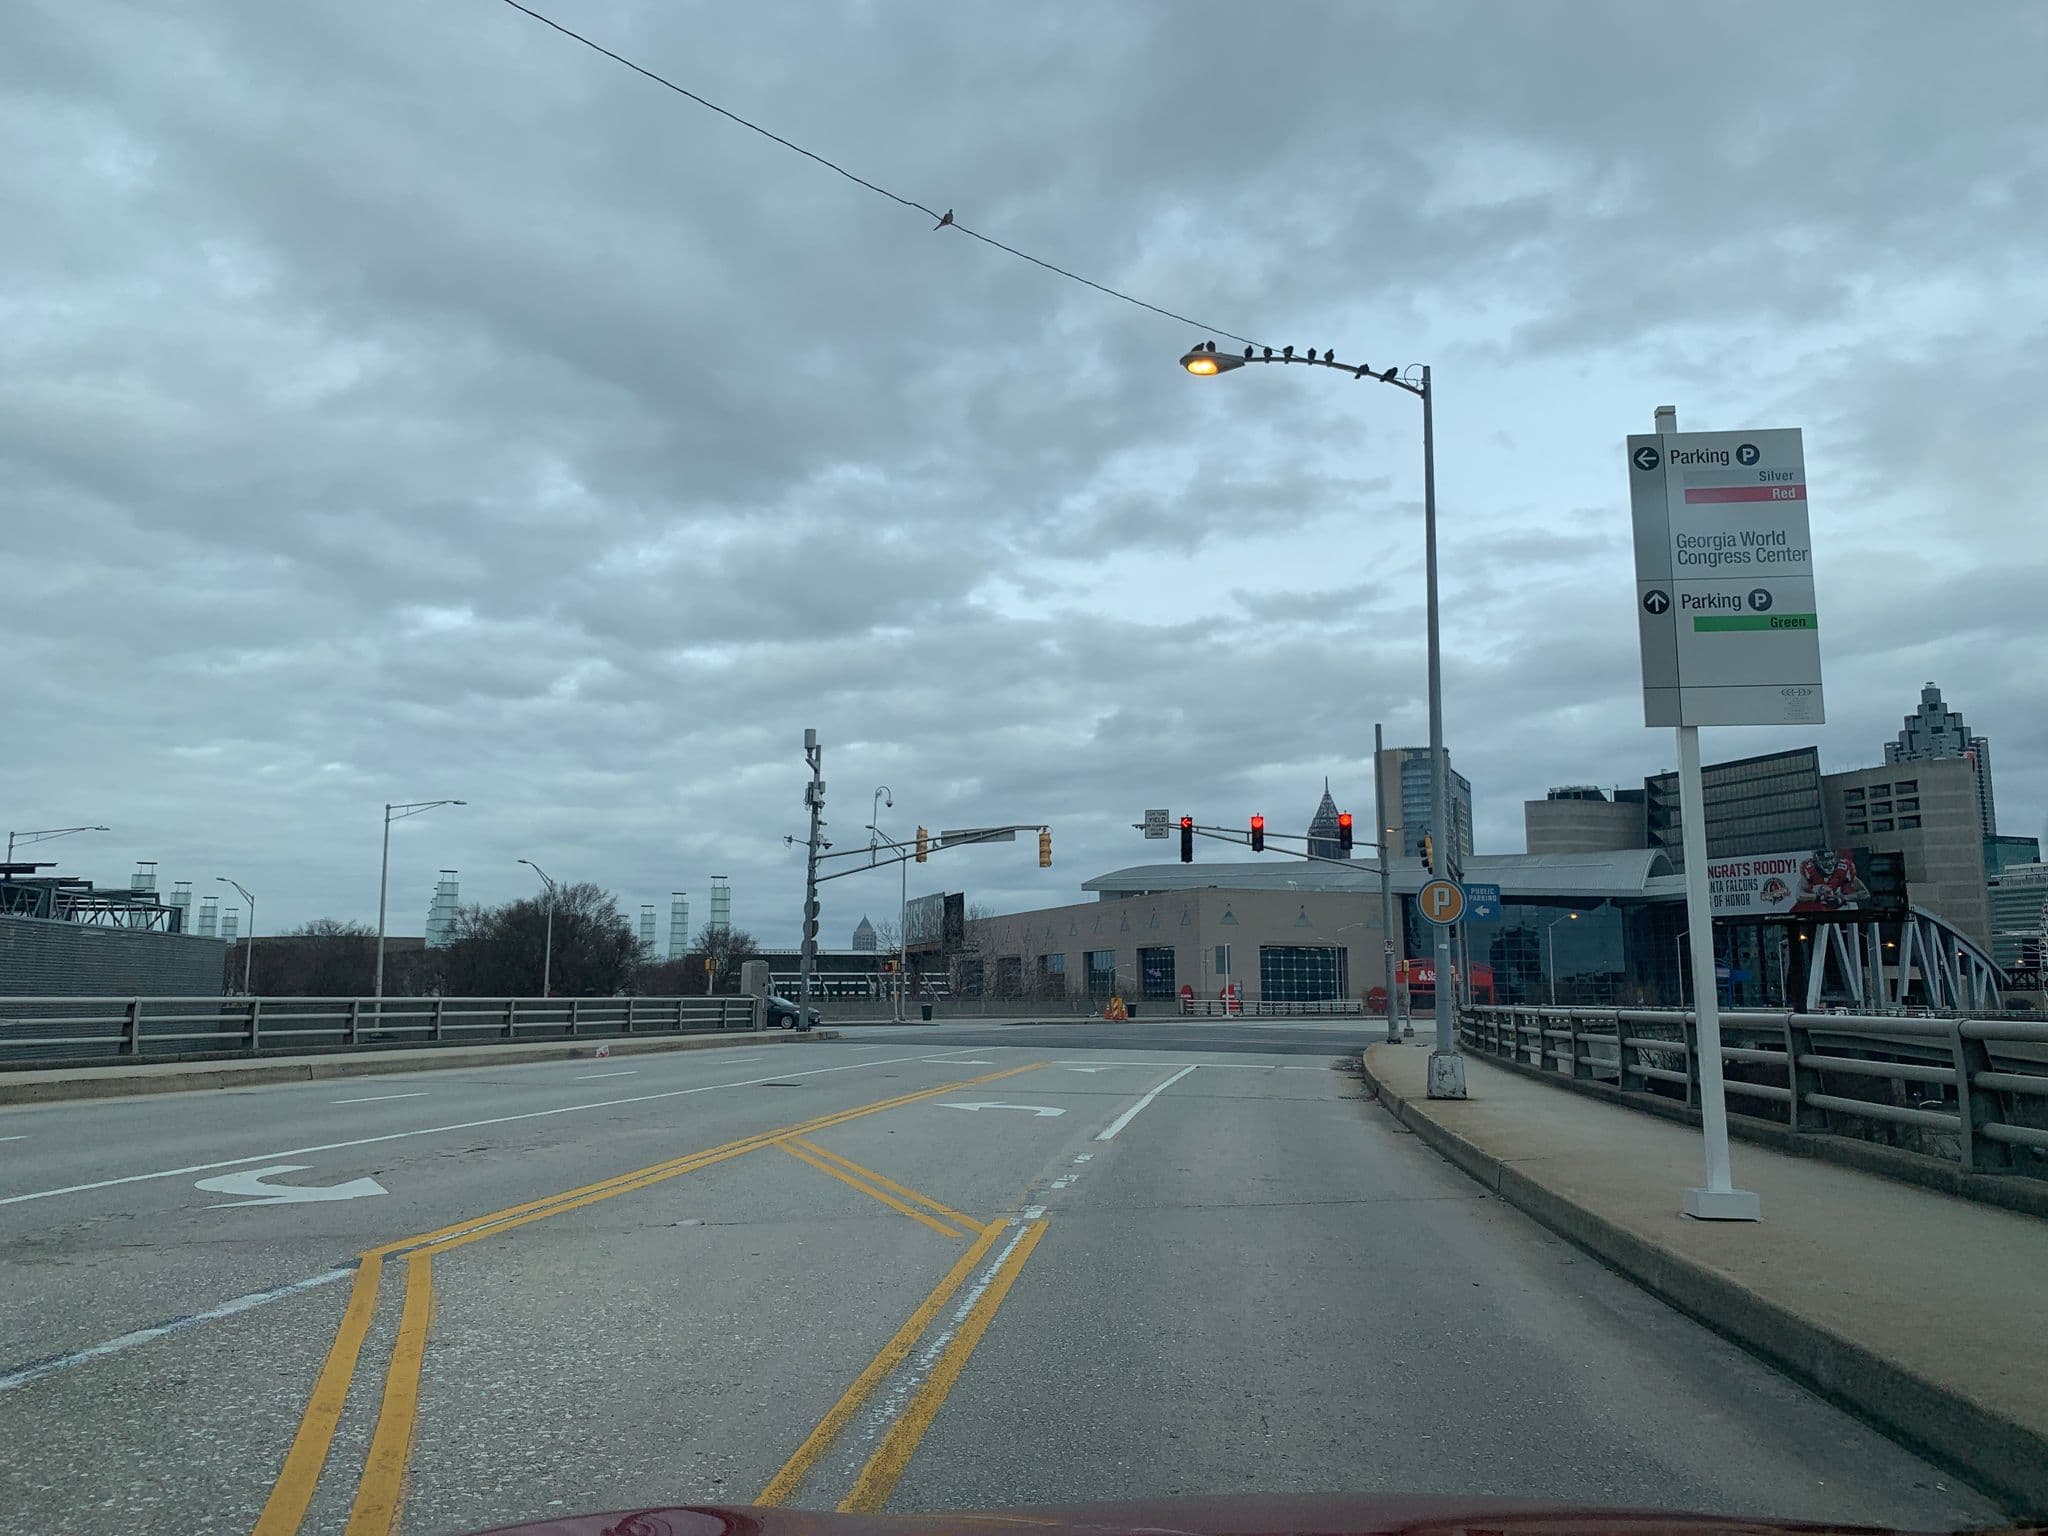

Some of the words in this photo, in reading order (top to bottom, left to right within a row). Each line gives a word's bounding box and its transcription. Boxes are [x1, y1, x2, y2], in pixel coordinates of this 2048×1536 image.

[1670, 448, 1730, 467] Parking
[1759, 470, 1794, 482] Silver
[1772, 487, 1796, 499] Red
[1676, 532, 1737, 551] Georgia
[1740, 530, 1786, 547] World
[1677, 549, 1751, 568] Congress
[1755, 547, 1808, 563] Center
[1681, 592, 1742, 611] Parking
[1770, 616, 1807, 628] Green
[1707, 862, 1750, 879] NGRATS
[1753, 858, 1797, 875] RODDY!
[1725, 878, 1759, 893] FALCONS
[1433, 887, 1450, 915] P
[1713, 894, 1724, 907] OF
[1725, 893, 1751, 907] HONOR
